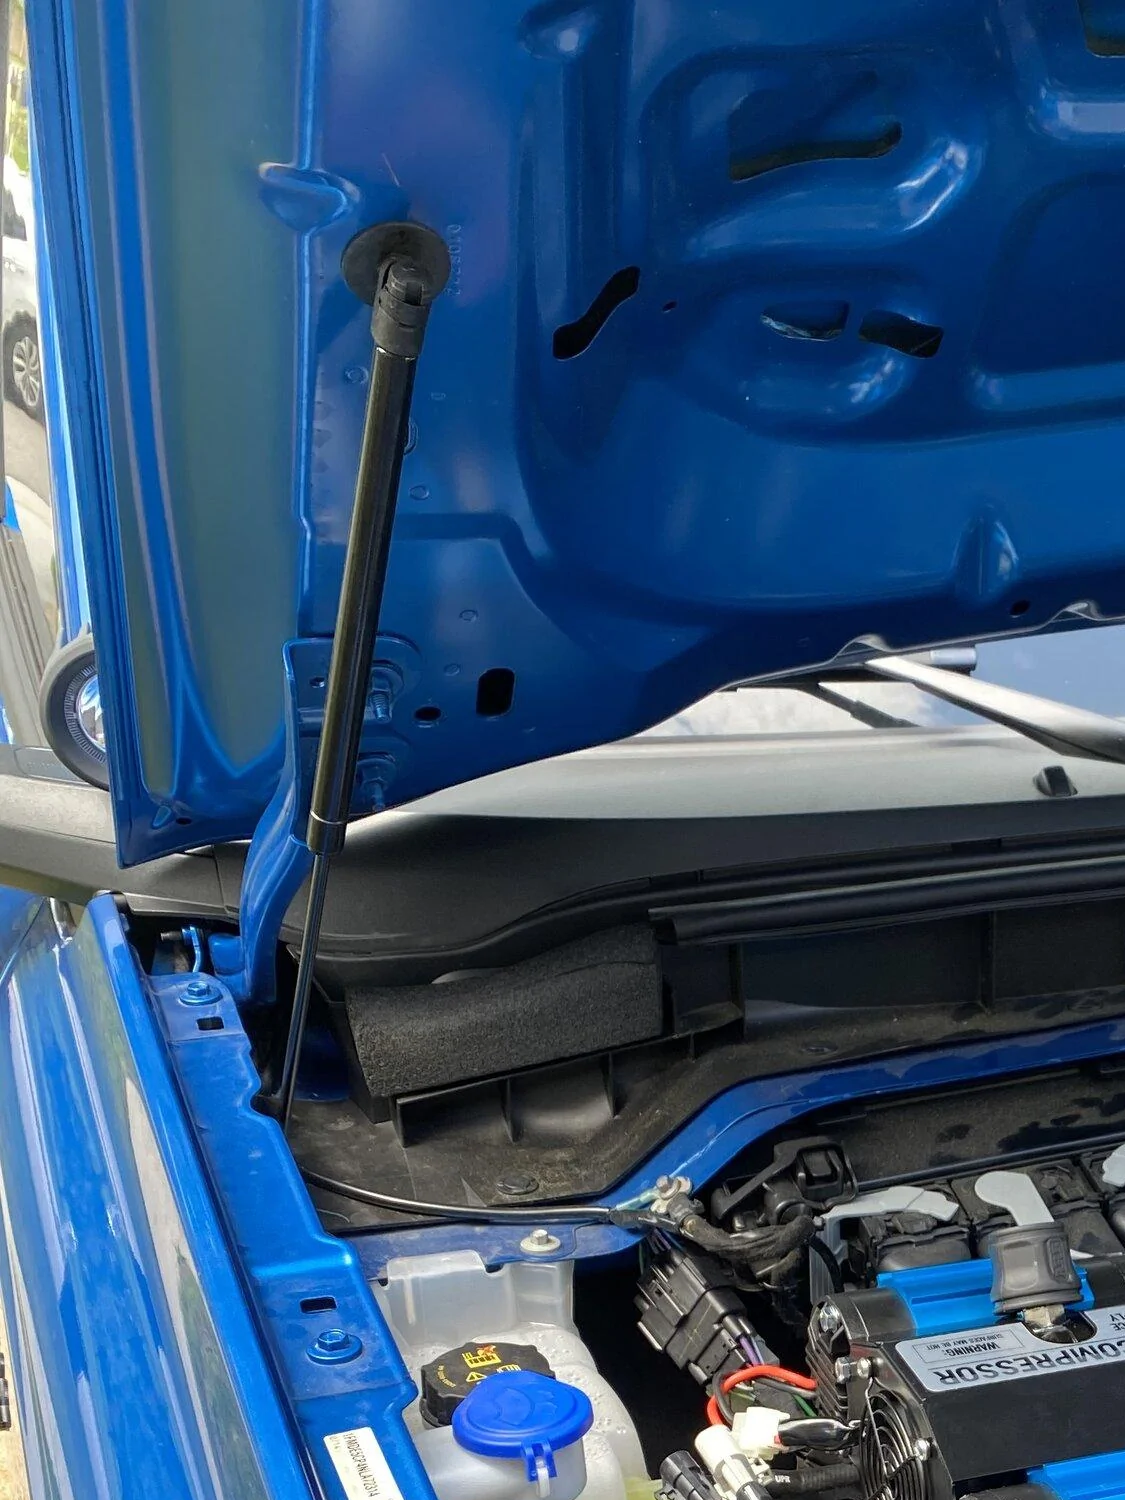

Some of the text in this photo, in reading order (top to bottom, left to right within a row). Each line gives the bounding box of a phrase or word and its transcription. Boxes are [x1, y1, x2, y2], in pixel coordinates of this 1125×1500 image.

[953, 1339, 968, 1347] MAY
[943, 1341, 1001, 1356] WARNING:
[774, 1474, 791, 1483] UPR
